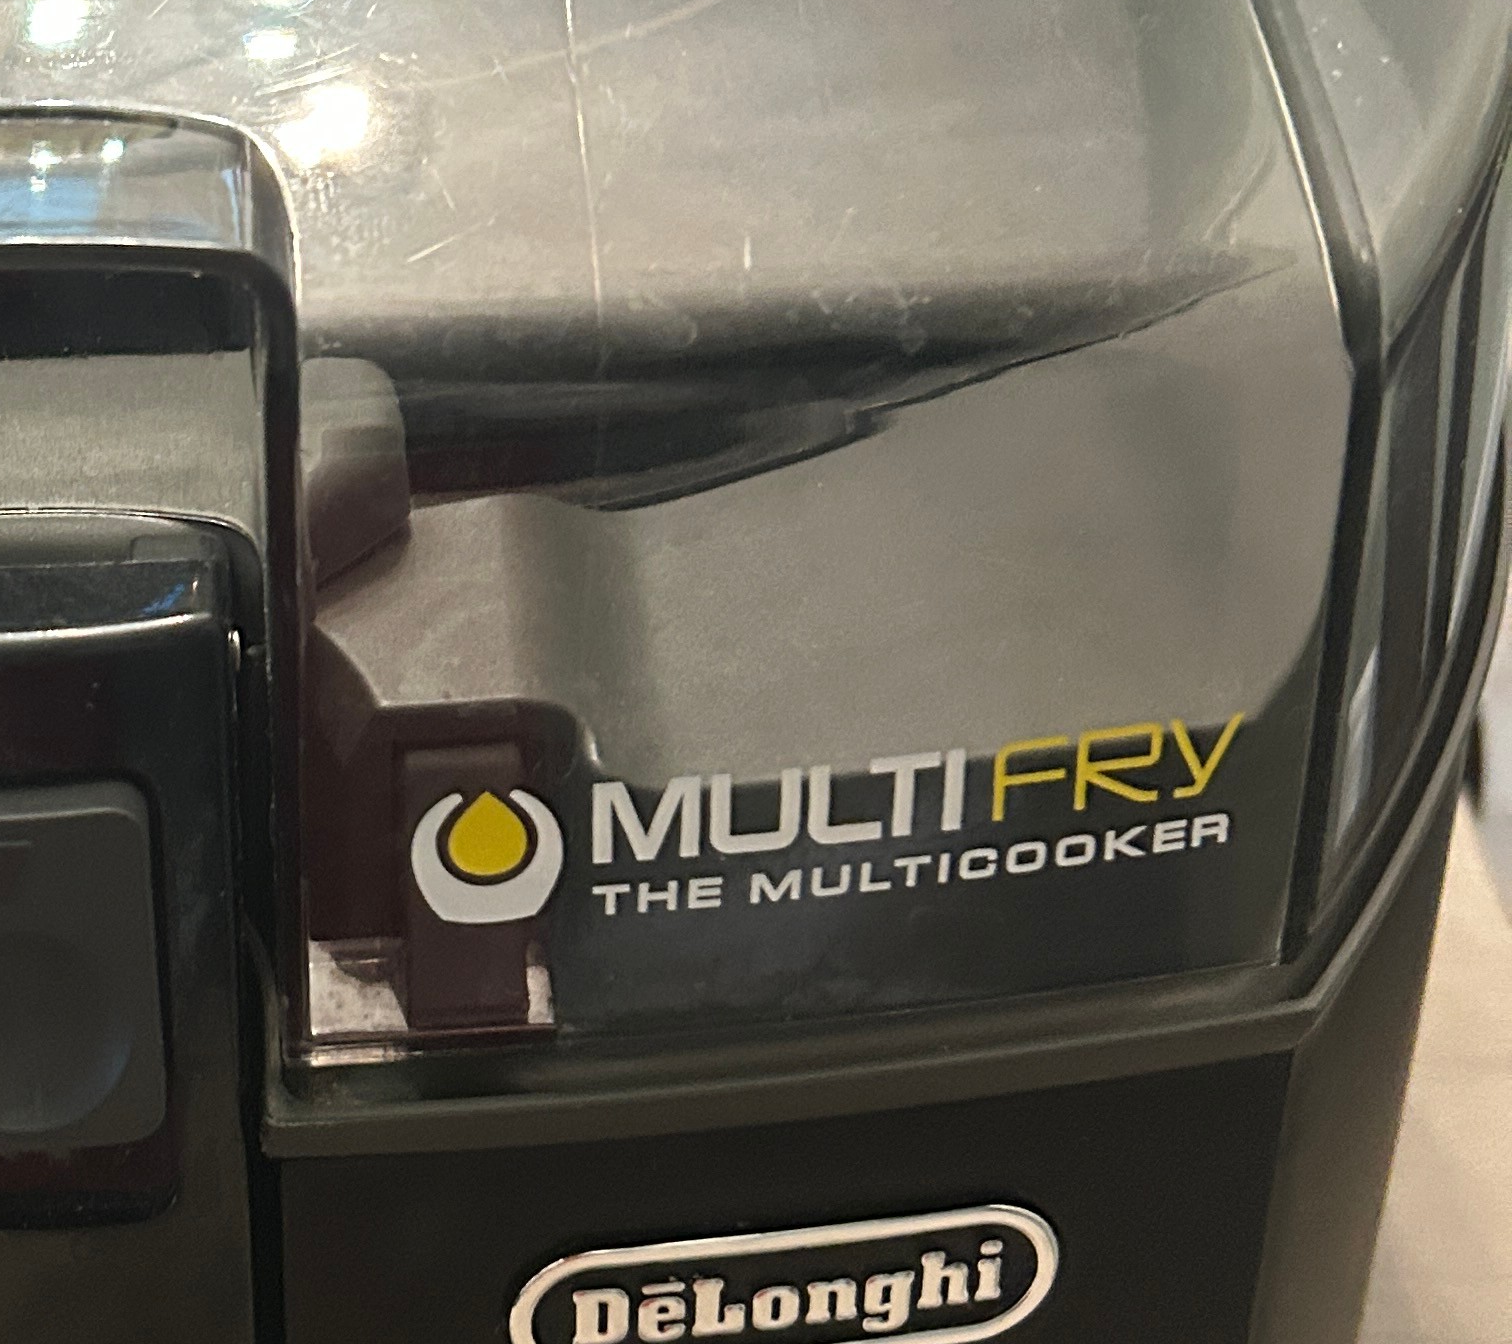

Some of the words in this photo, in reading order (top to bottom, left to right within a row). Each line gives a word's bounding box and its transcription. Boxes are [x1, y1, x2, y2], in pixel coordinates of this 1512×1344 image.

[591, 748, 967, 864] MULTI
[591, 875, 725, 916] THE
[748, 812, 1231, 904] MULTICOOKER
